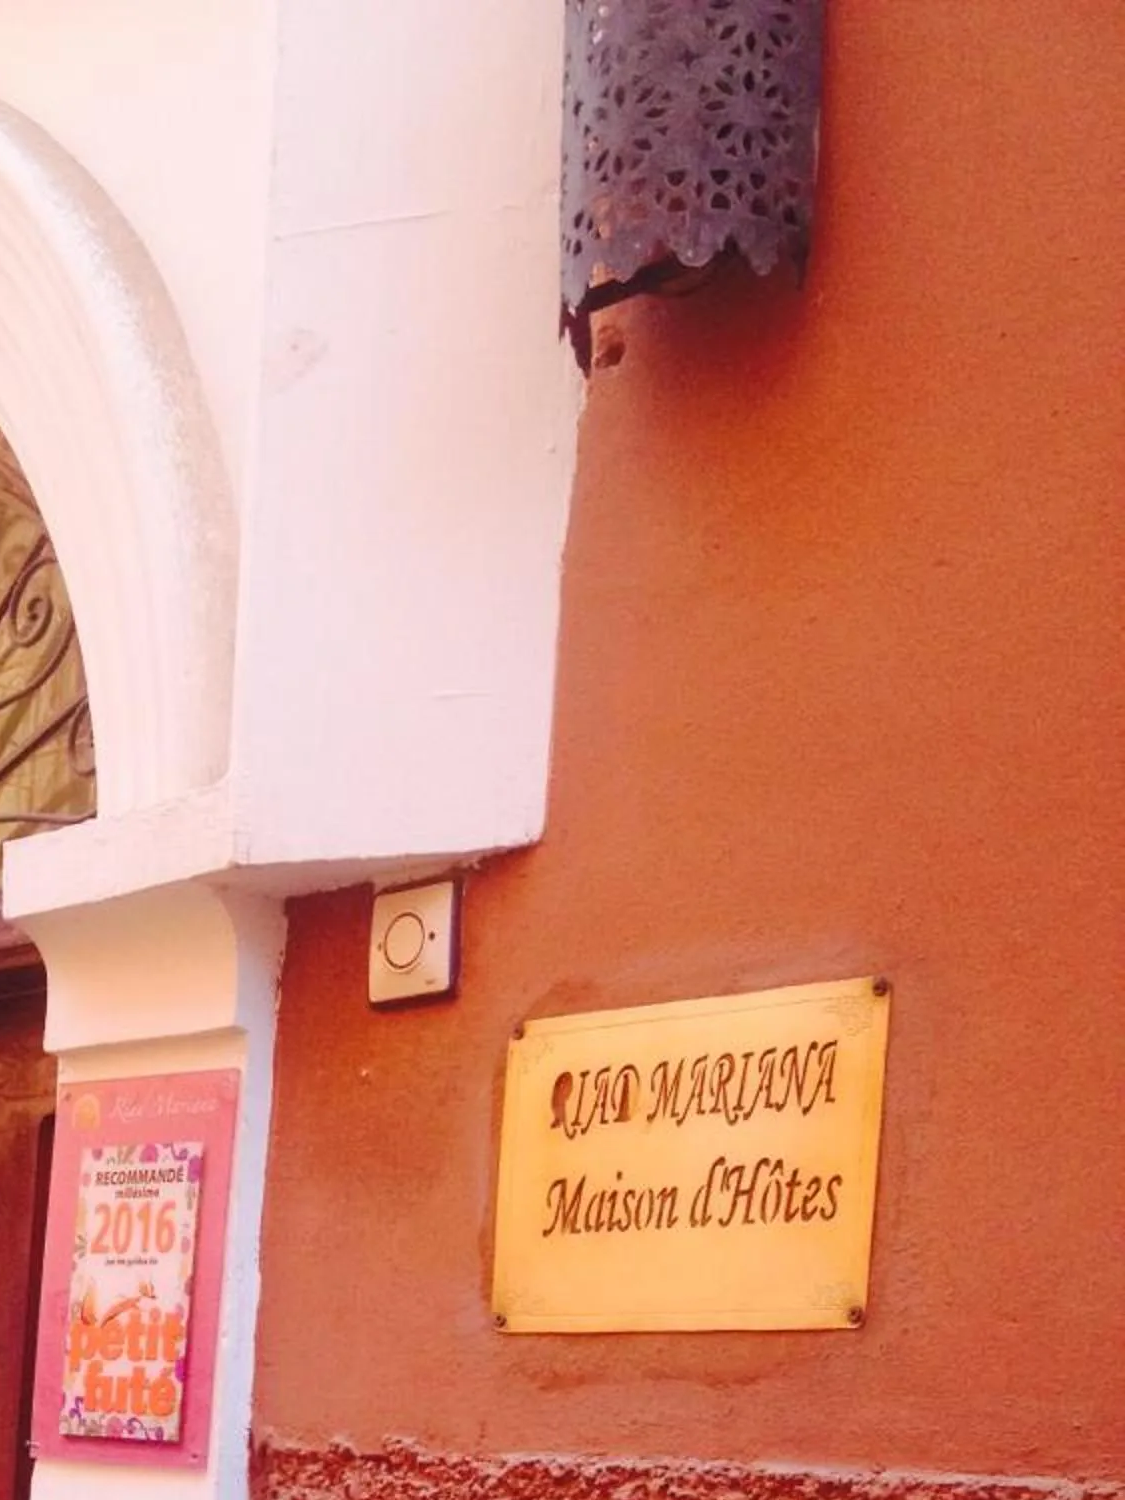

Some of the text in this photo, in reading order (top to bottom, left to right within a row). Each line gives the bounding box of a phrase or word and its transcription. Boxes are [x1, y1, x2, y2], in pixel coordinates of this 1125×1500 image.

[549, 1039, 838, 1140] RIAD MARIANA
[95, 1164, 184, 1186] RECOMMANDÉ
[542, 1156, 843, 1237] Maison d'Hôtes
[89, 1200, 177, 1254] 2016
[68, 1306, 184, 1373] petit
[83, 1360, 177, 1417] futé
